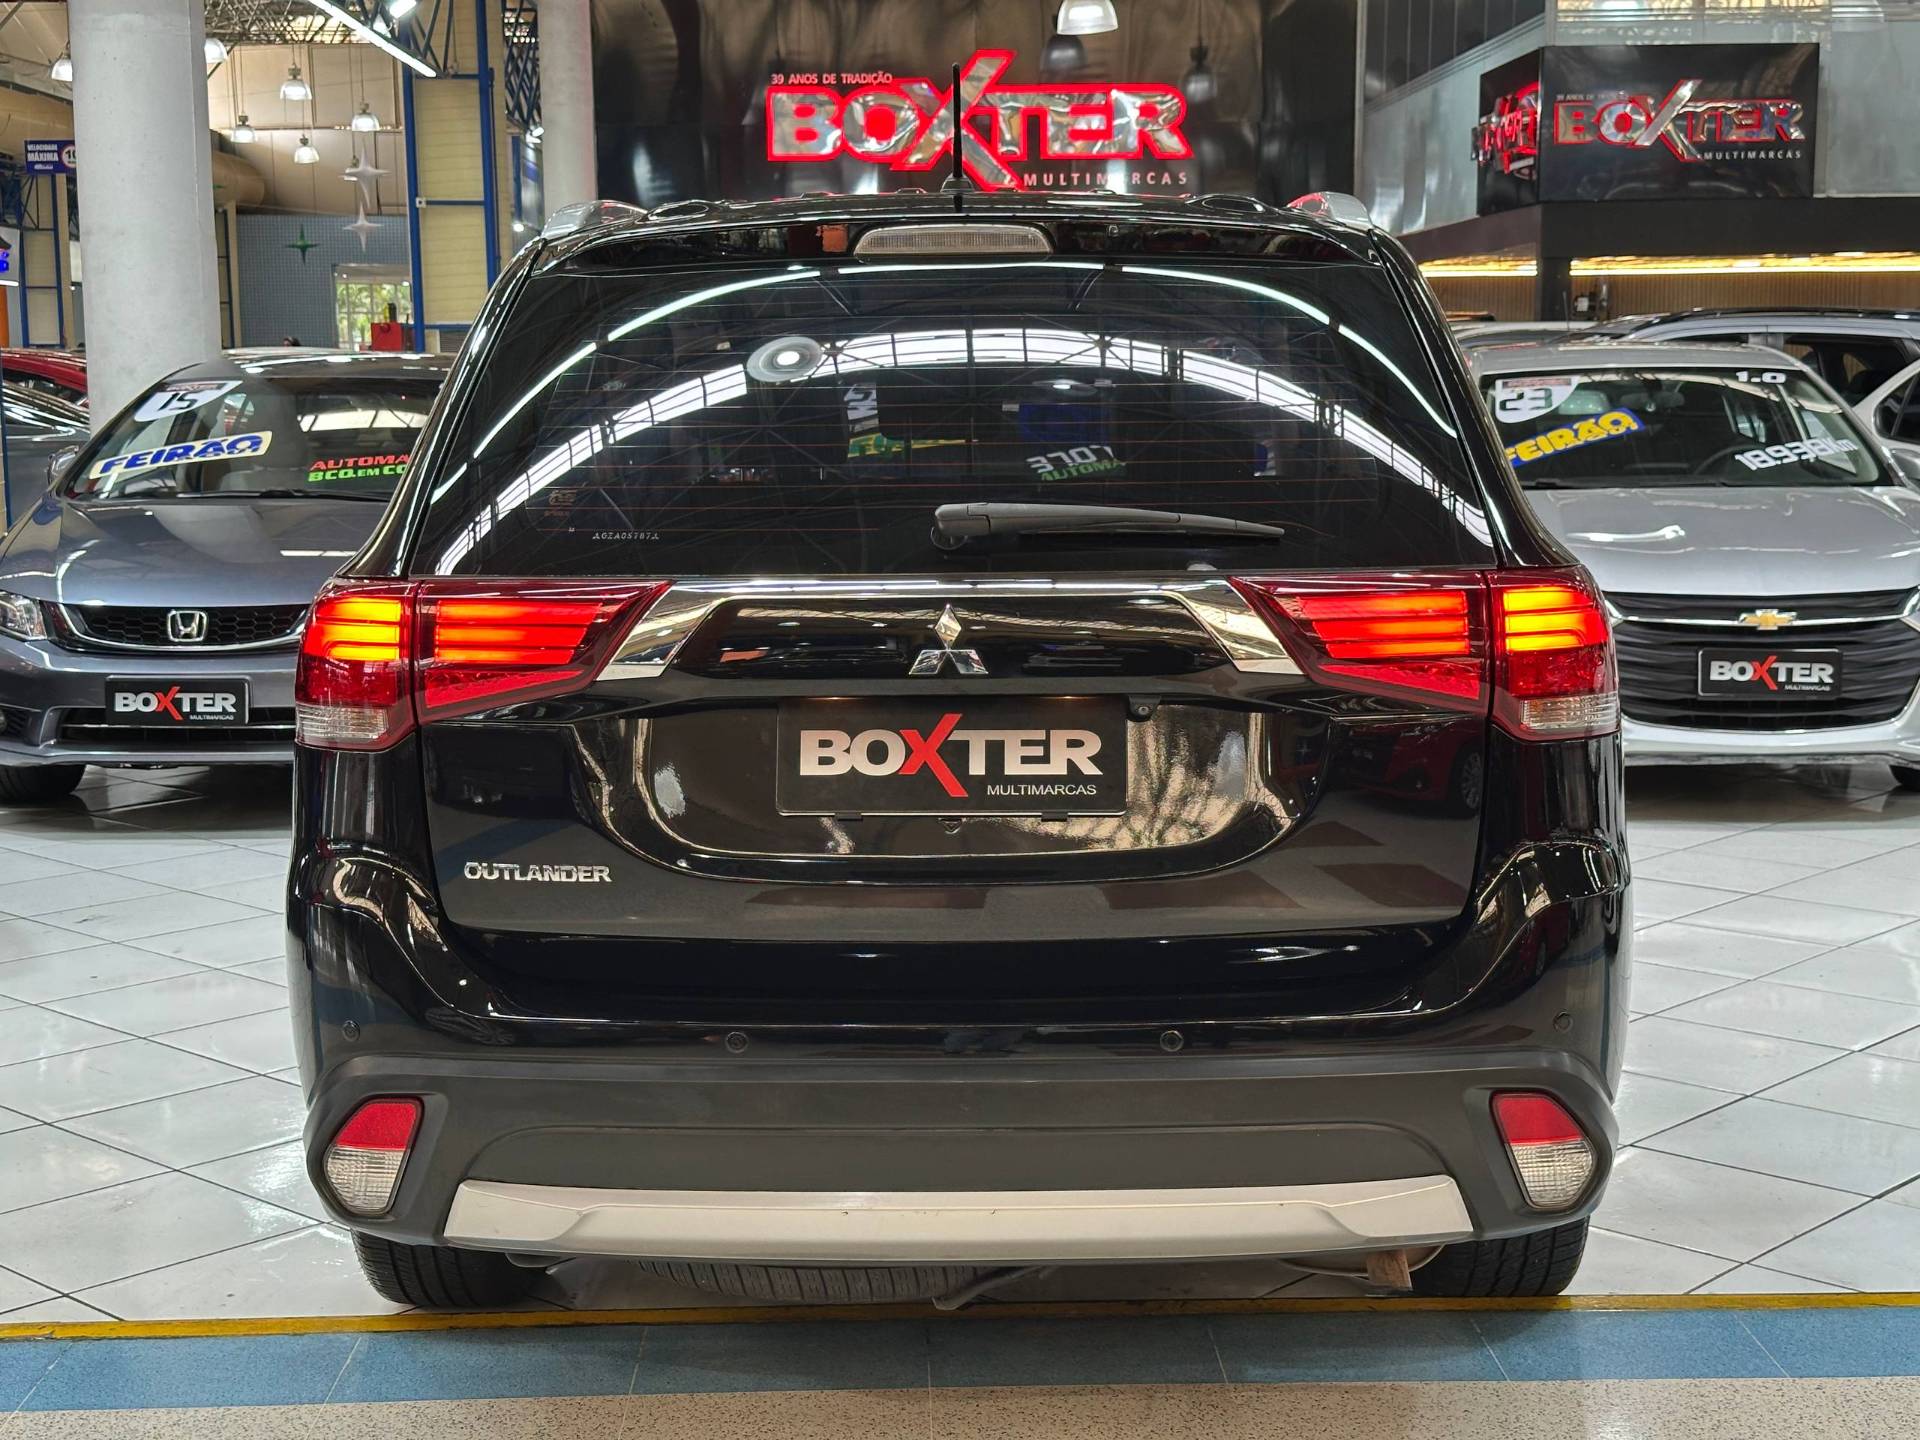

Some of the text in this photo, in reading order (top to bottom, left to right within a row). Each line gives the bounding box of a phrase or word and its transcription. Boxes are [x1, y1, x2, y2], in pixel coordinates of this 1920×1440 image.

[771, 71, 893, 86] 39 ANOS DE TRADIÇÃO
[768, 49, 1194, 191] BOXTER
[1553, 79, 1806, 162] BOXTER
[1704, 151, 1802, 161] MULTIMARCAS
[1023, 172, 1188, 186] MULTIMRCAS
[1736, 371, 1786, 383] 1.0
[1710, 655, 1834, 690] BOXTER
[114, 686, 237, 720] BOXTER
[800, 713, 1104, 797] BOXTER
[986, 784, 1097, 796] MULTIMARCAS
[464, 862, 612, 882] OUTLANDER
